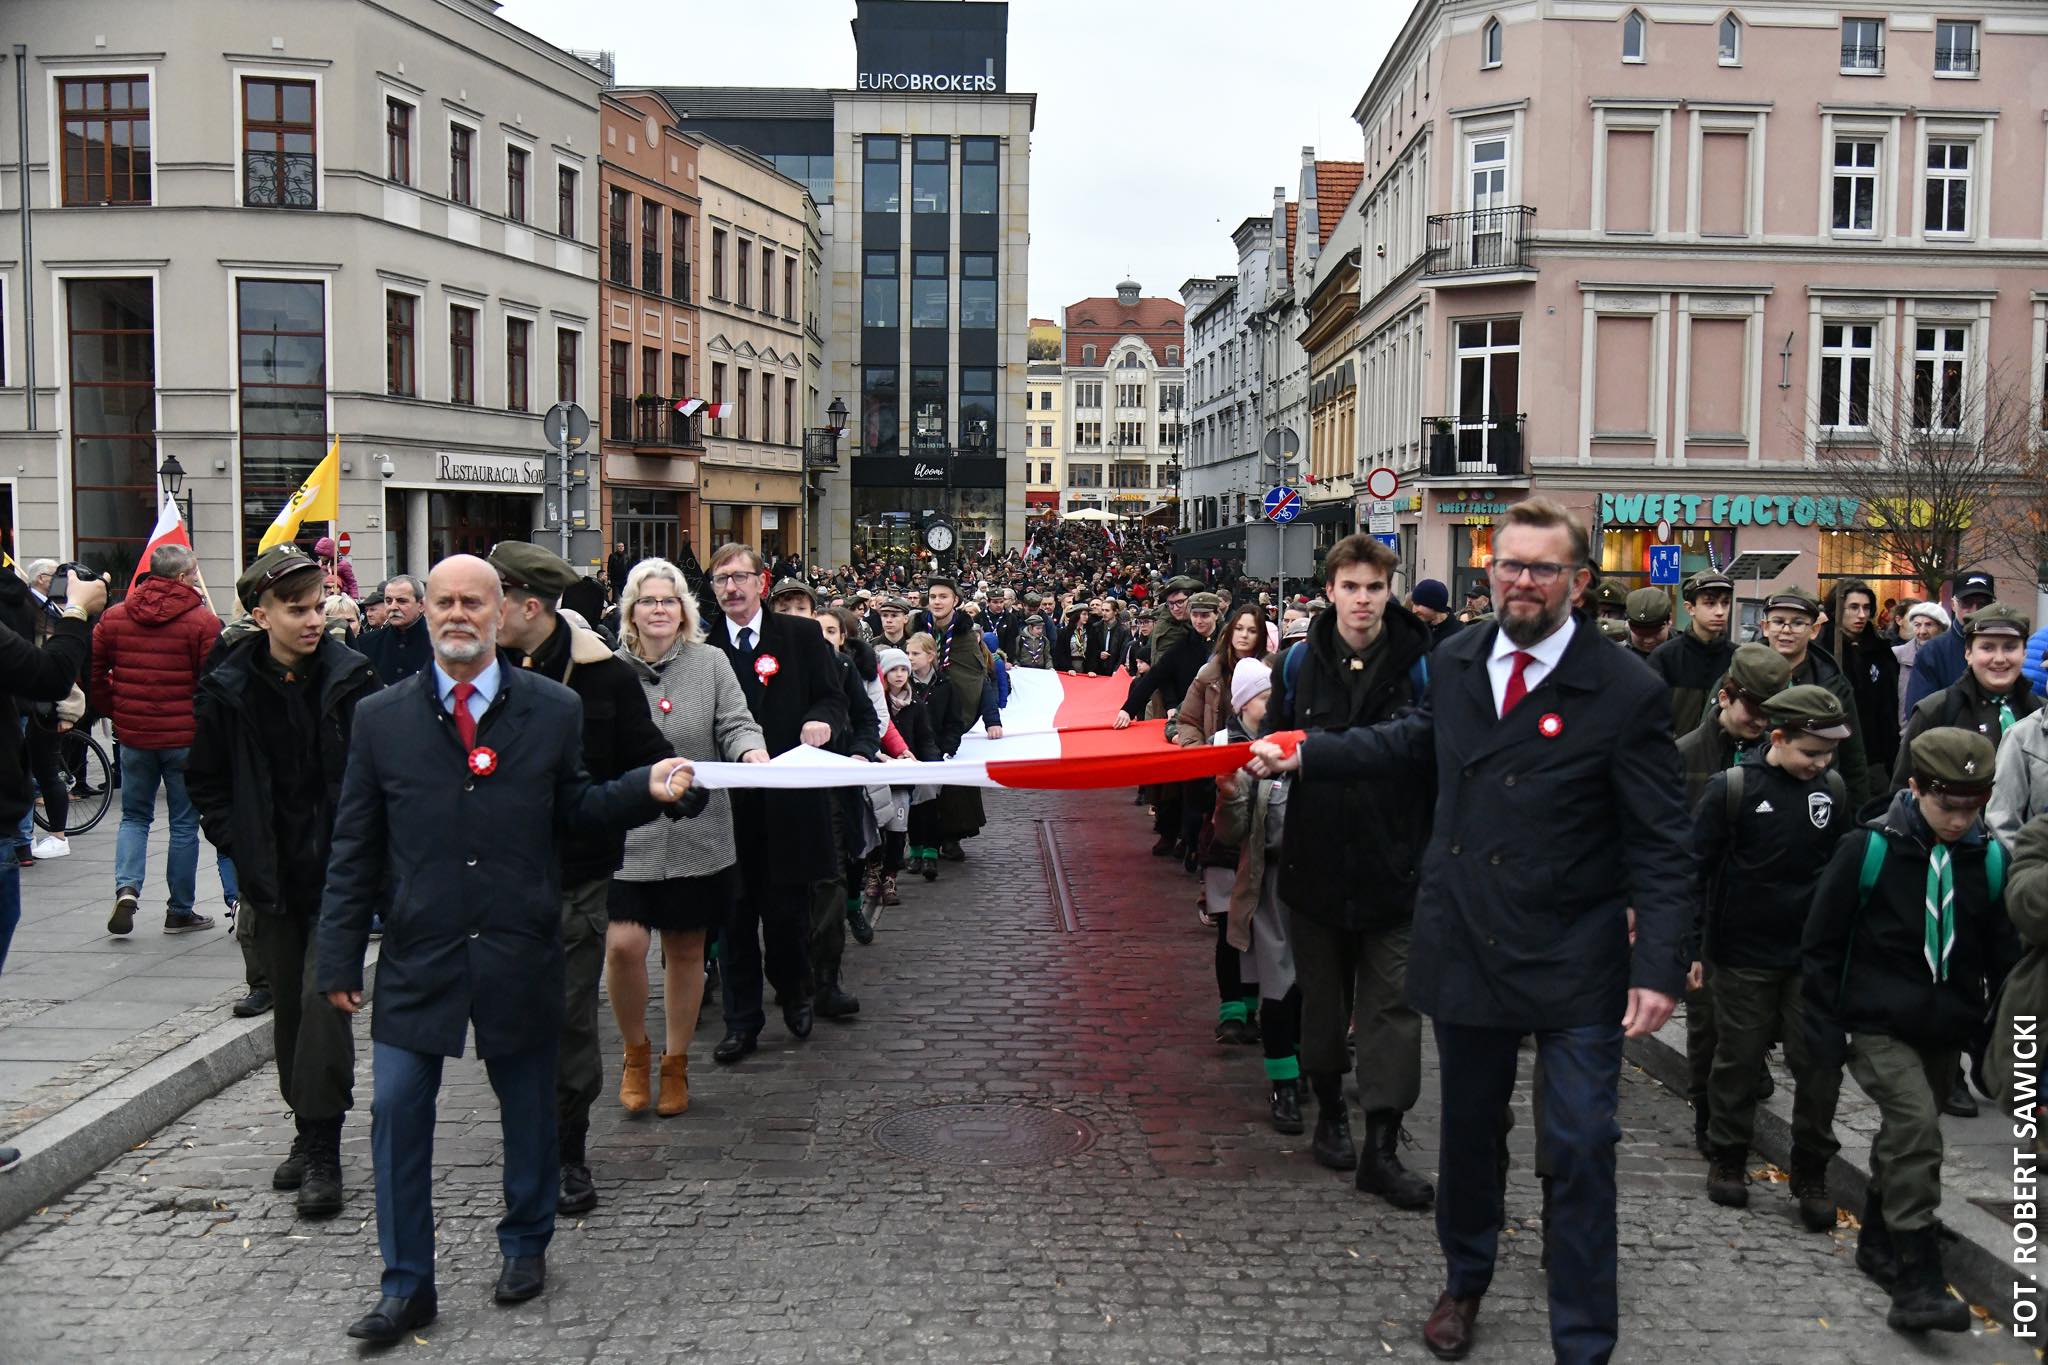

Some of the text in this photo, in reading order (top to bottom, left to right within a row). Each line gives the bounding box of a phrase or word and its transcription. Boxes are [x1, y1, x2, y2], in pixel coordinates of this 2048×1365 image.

[859, 73, 996, 91] EUROBROKERS
[1437, 503, 1467, 513] SWEET
[1602, 493, 1702, 525] SWEET
[1712, 494, 1859, 526] FACTORY
[1464, 515, 1491, 525] STORE
[897, 807, 905, 821] 9
